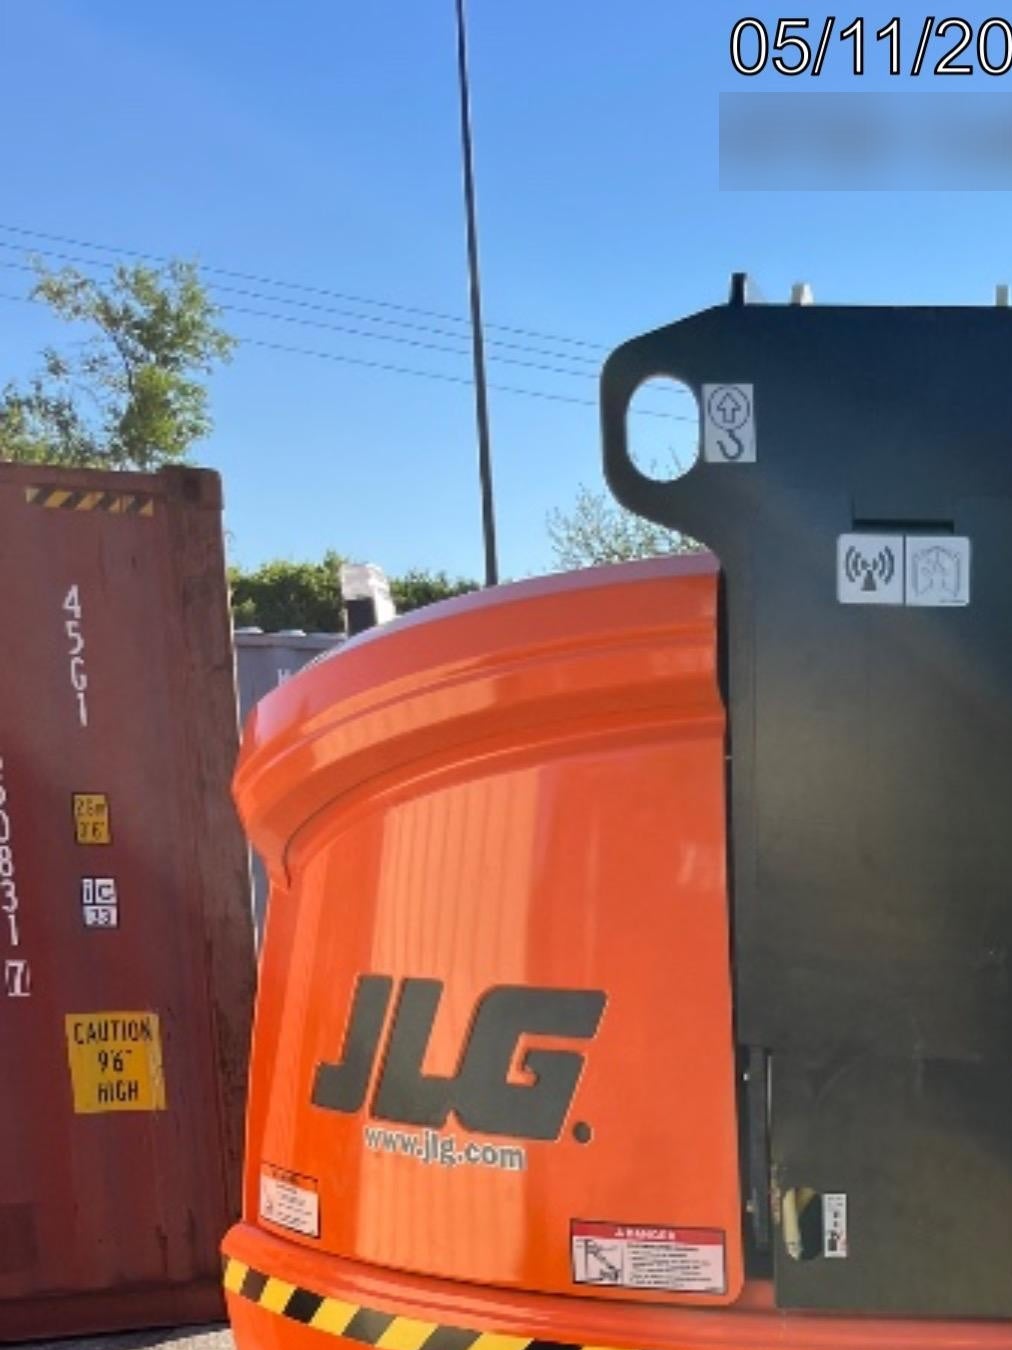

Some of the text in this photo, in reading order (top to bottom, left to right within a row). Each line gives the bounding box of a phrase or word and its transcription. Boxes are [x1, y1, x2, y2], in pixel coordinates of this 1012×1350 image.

[62, 583, 89, 728] 45G1
[74, 1018, 152, 1045] CAUTION
[98, 1080, 138, 1104] HIGH
[363, 1126, 526, 1171] www.jlg.com
